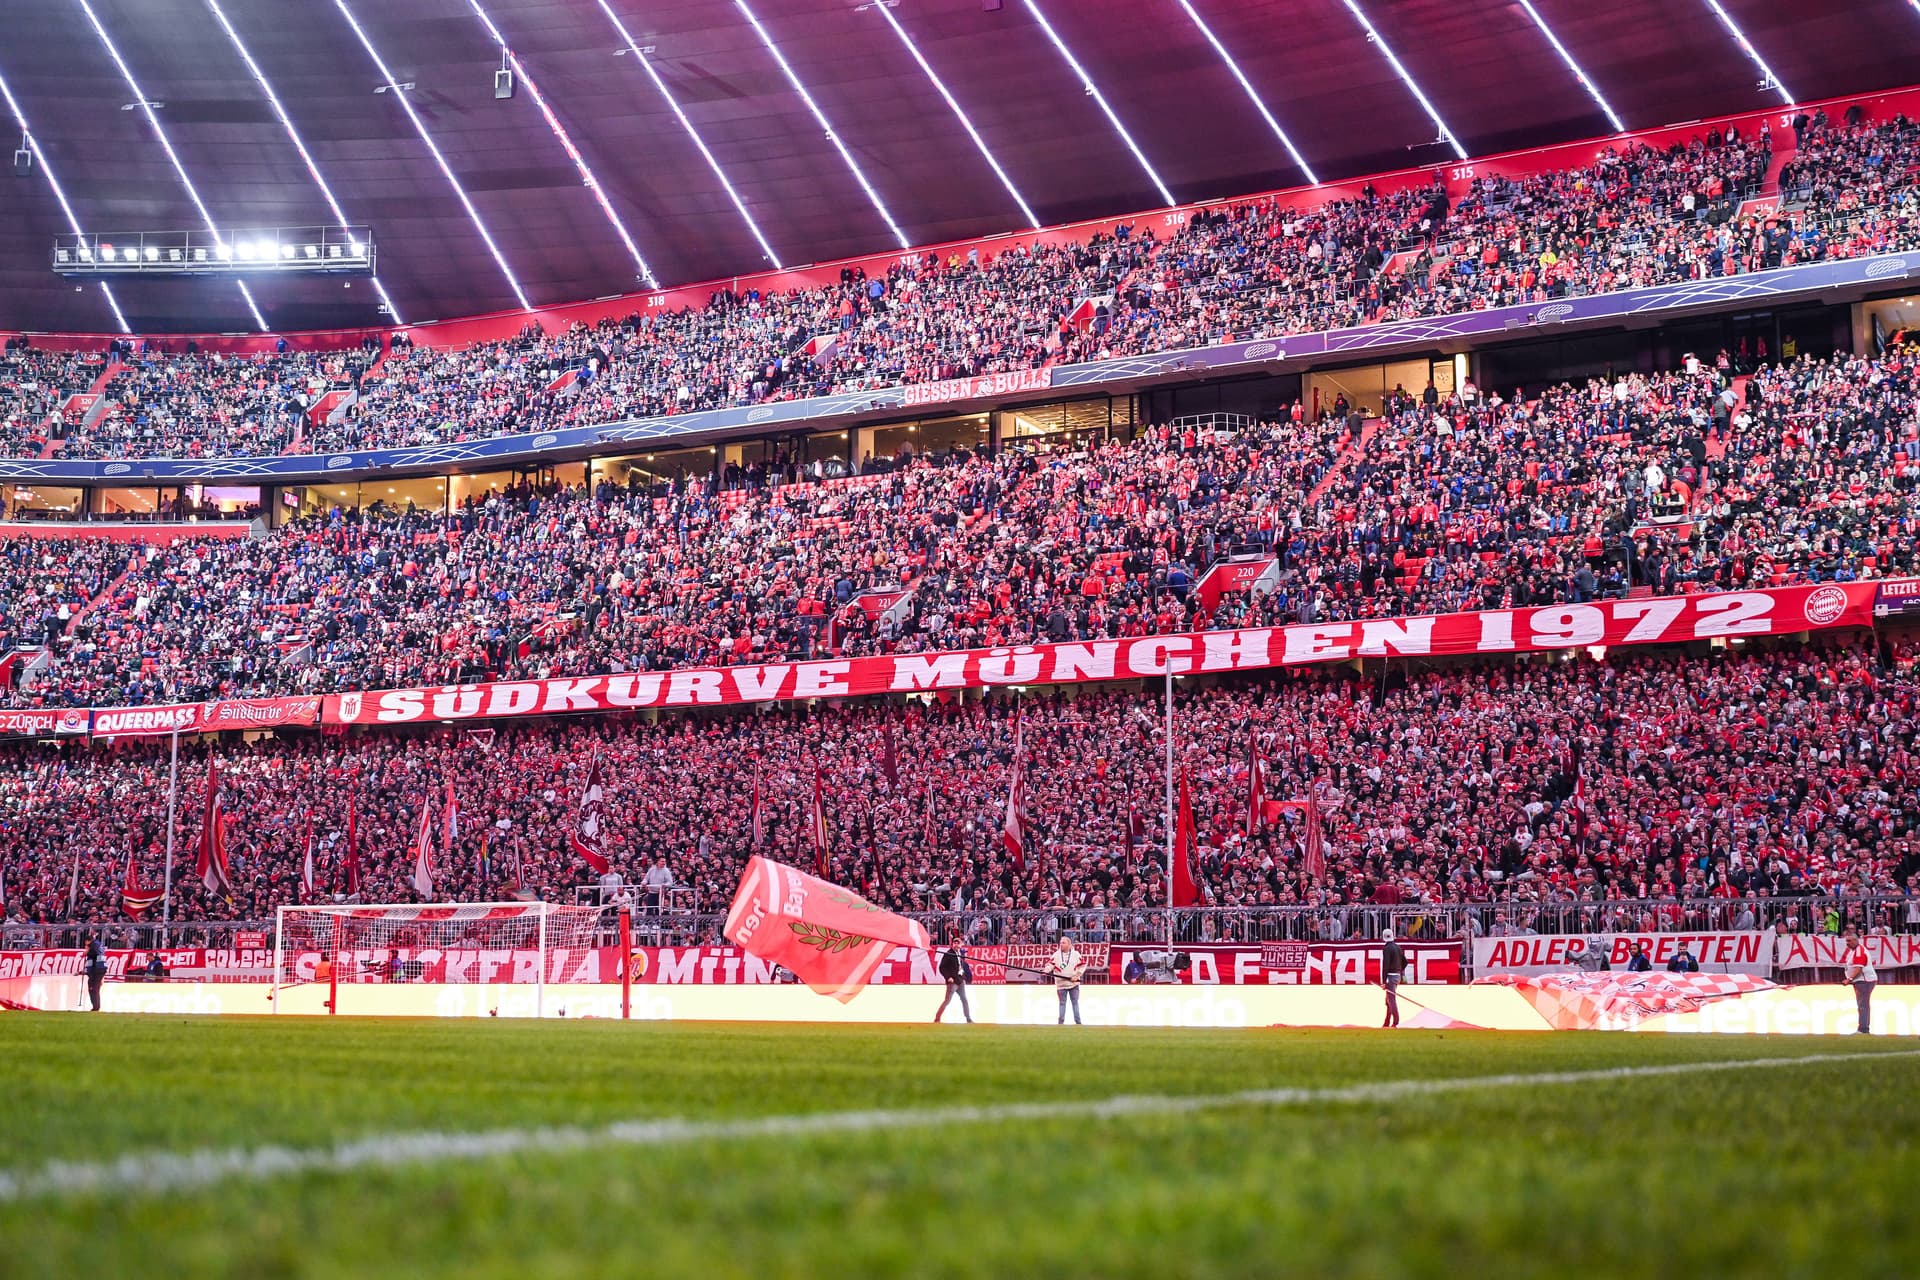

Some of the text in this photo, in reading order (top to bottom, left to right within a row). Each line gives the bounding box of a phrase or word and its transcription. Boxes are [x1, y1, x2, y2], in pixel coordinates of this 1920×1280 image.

[1452, 166, 1474, 180] 315
[1165, 213, 1185, 226] 316
[647, 296, 664, 307] 318
[904, 367, 1052, 404] GIESSEN BULLS
[1238, 567, 1254, 577] 220
[1882, 582, 1917, 596] LETZTE
[878, 598, 891, 608] 221
[377, 592, 1775, 722] SÜDKURVE MÜNCHEN 1972
[7, 713, 53, 729] ZÜRICH
[96, 707, 196, 731] QUEERPASS
[964, 947, 1007, 961] LTRAS
[1262, 951, 1306, 963] JUNGS!
[656, 948, 949, 984] MÜNEN
[969, 963, 1006, 977] GEN
